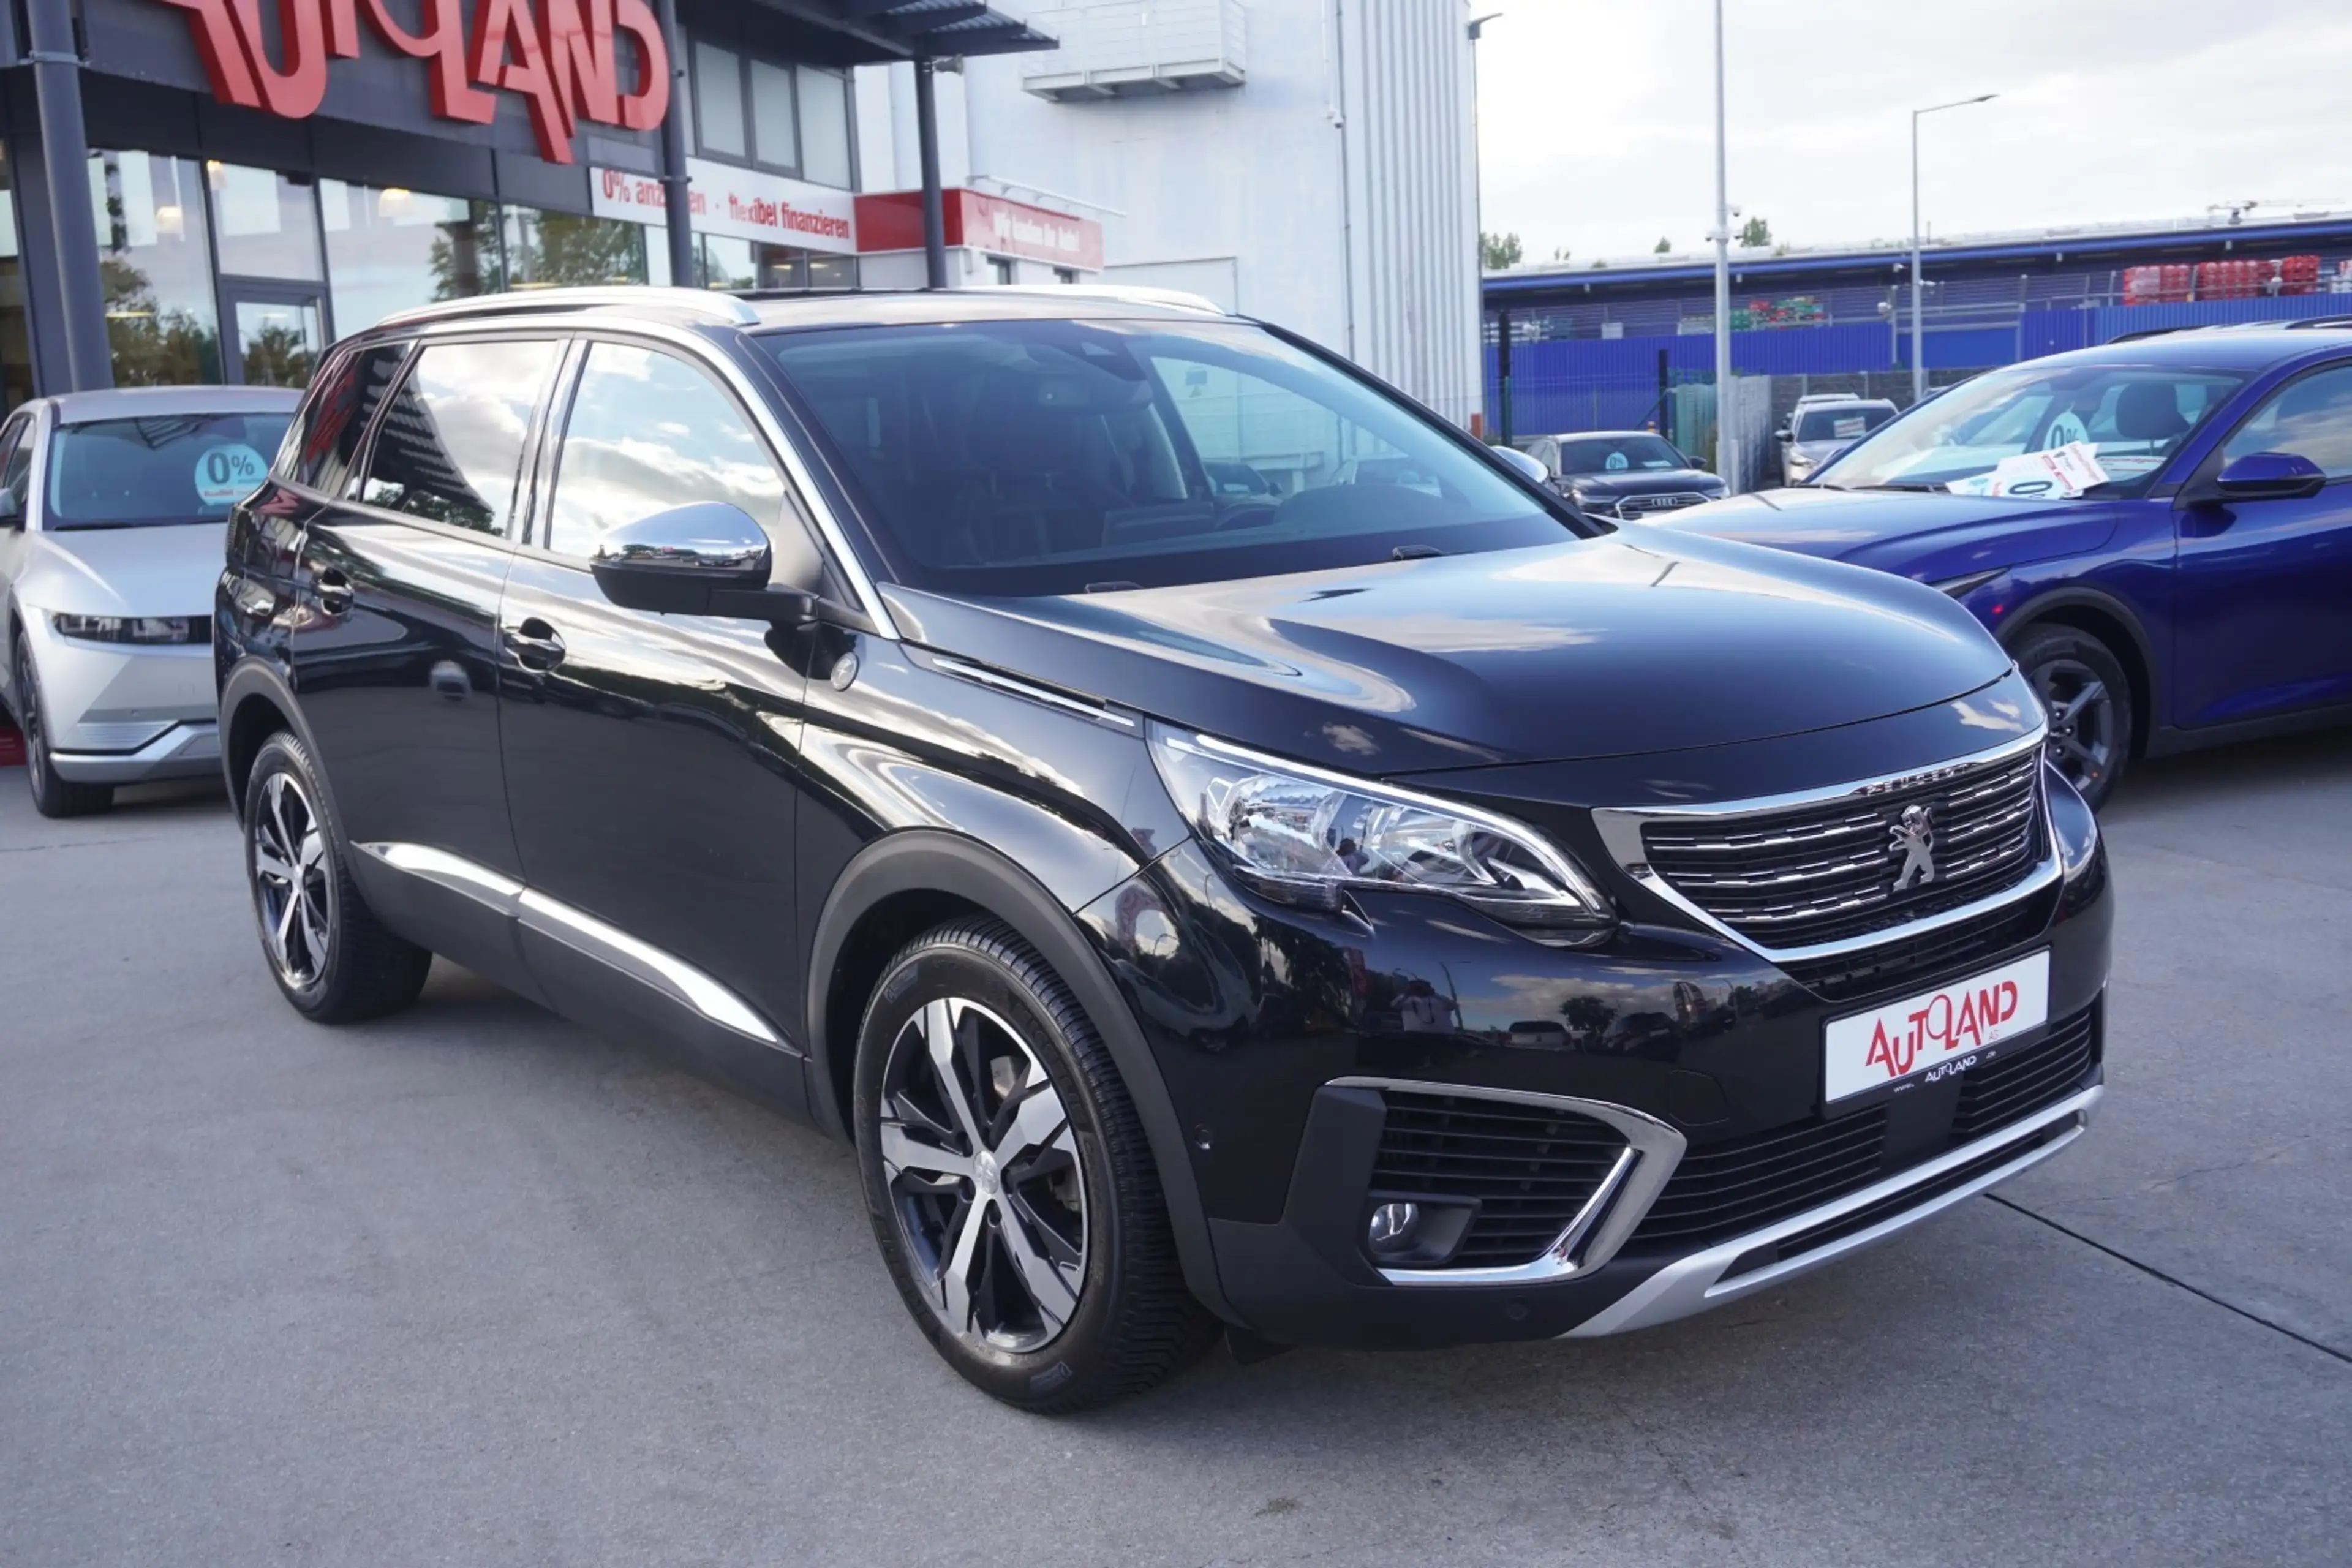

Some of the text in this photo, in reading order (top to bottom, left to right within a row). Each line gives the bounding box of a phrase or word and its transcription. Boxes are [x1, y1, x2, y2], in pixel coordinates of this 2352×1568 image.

[603, 168, 631, 203] 0%
[781, 201, 850, 239] finanzieren
[207, 453, 255, 484] 0%
[1865, 980, 2018, 1078] AUTOLAND
